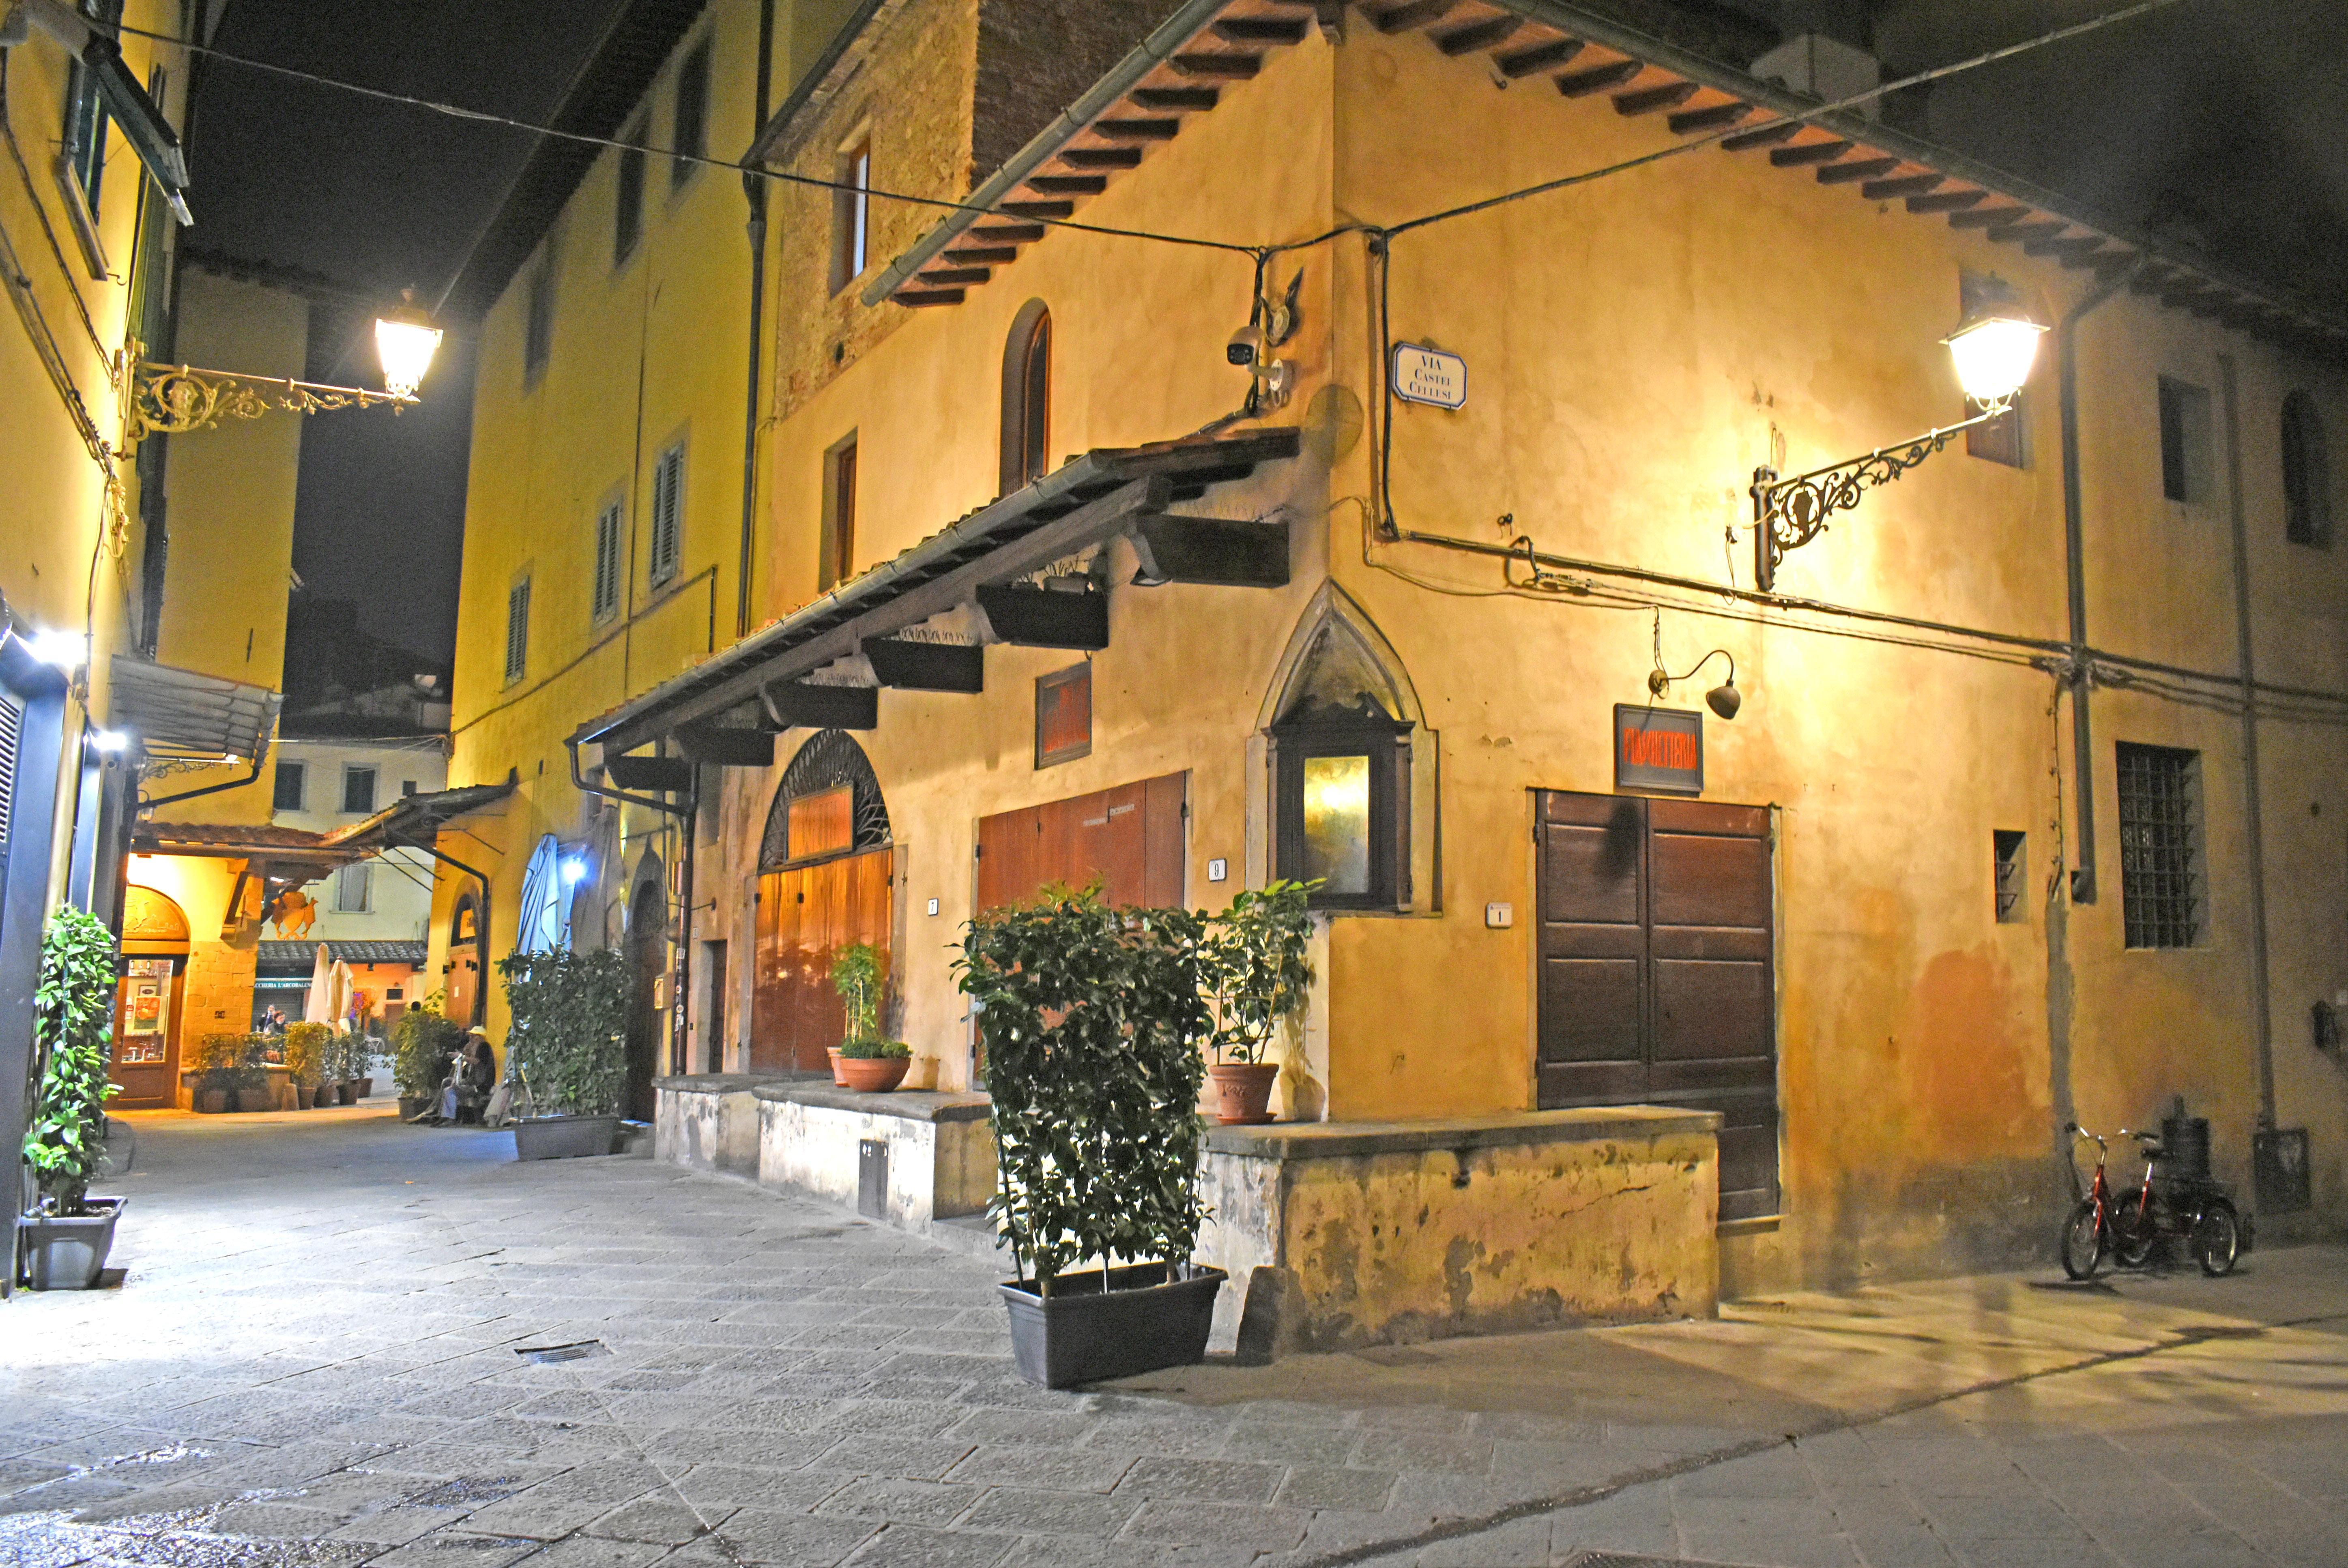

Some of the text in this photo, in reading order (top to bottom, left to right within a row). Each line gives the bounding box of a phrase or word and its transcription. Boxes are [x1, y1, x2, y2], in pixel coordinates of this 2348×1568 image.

[1422, 355, 1441, 370] VIA
[1415, 368, 1452, 386] CASTEL
[1409, 381, 1451, 399] CELLESI
[1215, 864, 1219, 877] 9
